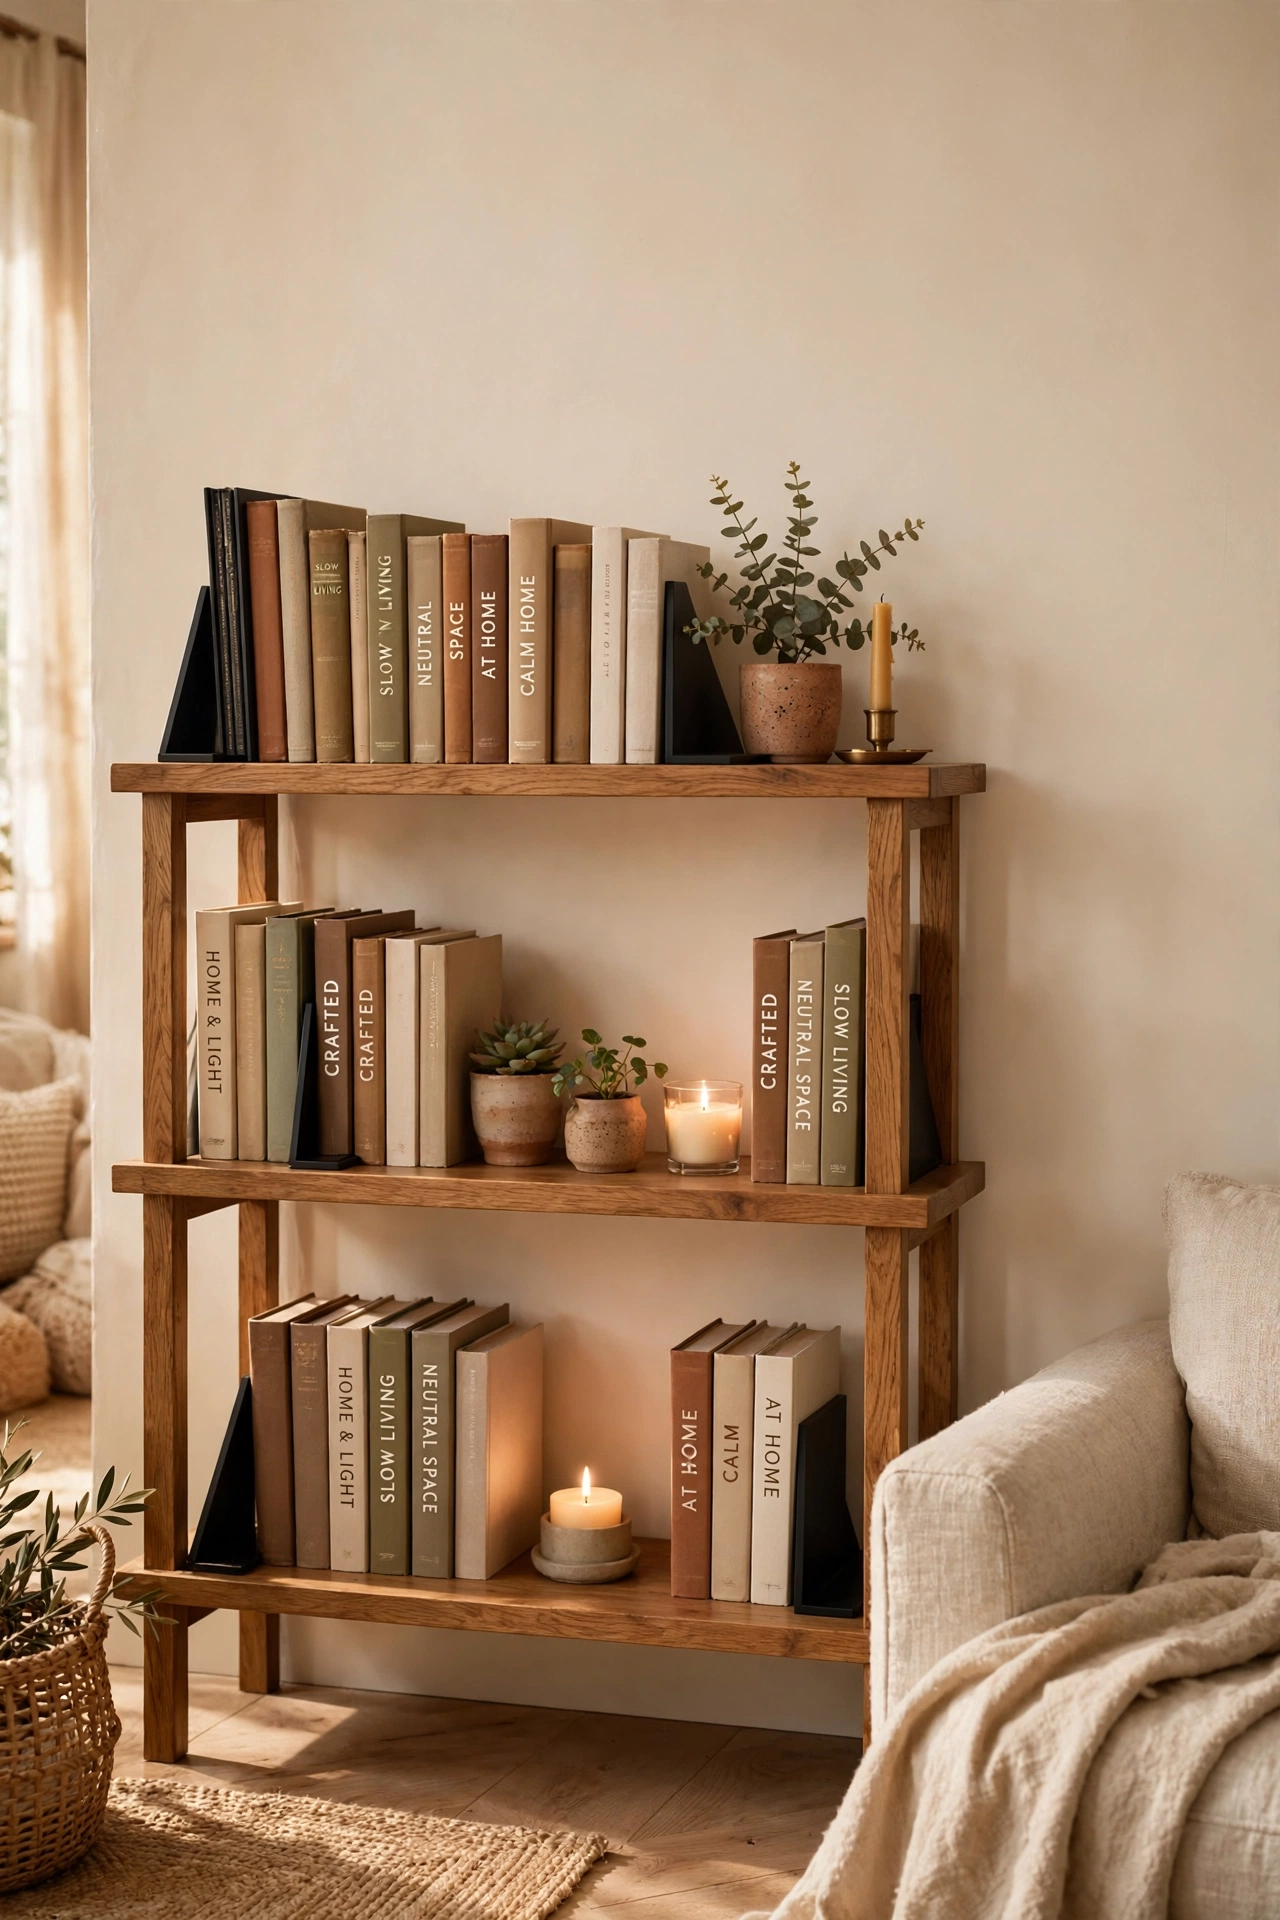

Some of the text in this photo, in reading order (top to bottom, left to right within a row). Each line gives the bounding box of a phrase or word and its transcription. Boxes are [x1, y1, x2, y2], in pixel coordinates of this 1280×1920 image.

[313, 585, 342, 595] LIVING
[315, 563, 339, 571] SLOW
[378, 555, 392, 610] LIVING
[379, 643, 394, 696] SLOW
[418, 601, 432, 686] NEUTRAL
[450, 602, 464, 660] SPACE
[481, 591, 496, 679] AT HOME
[520, 575, 535, 696] CALM HOME
[206, 951, 222, 1094] HOME & LIGHT
[323, 980, 340, 1077] CRAFTED
[359, 989, 374, 1082] CRAFTED
[760, 993, 777, 1090] CRAFTED
[795, 980, 813, 1131] NEUTRAL SPACE
[832, 983, 850, 1114] SLOW LIVING
[338, 1367, 354, 1508] HOME & LIGHT
[380, 1374, 395, 1503] SLOW LIVING
[422, 1364, 438, 1514] NEUTRAL SPACE
[681, 1409, 698, 1512] AT HOME
[723, 1424, 740, 1483] CALM
[764, 1397, 781, 1498] AT HOME
